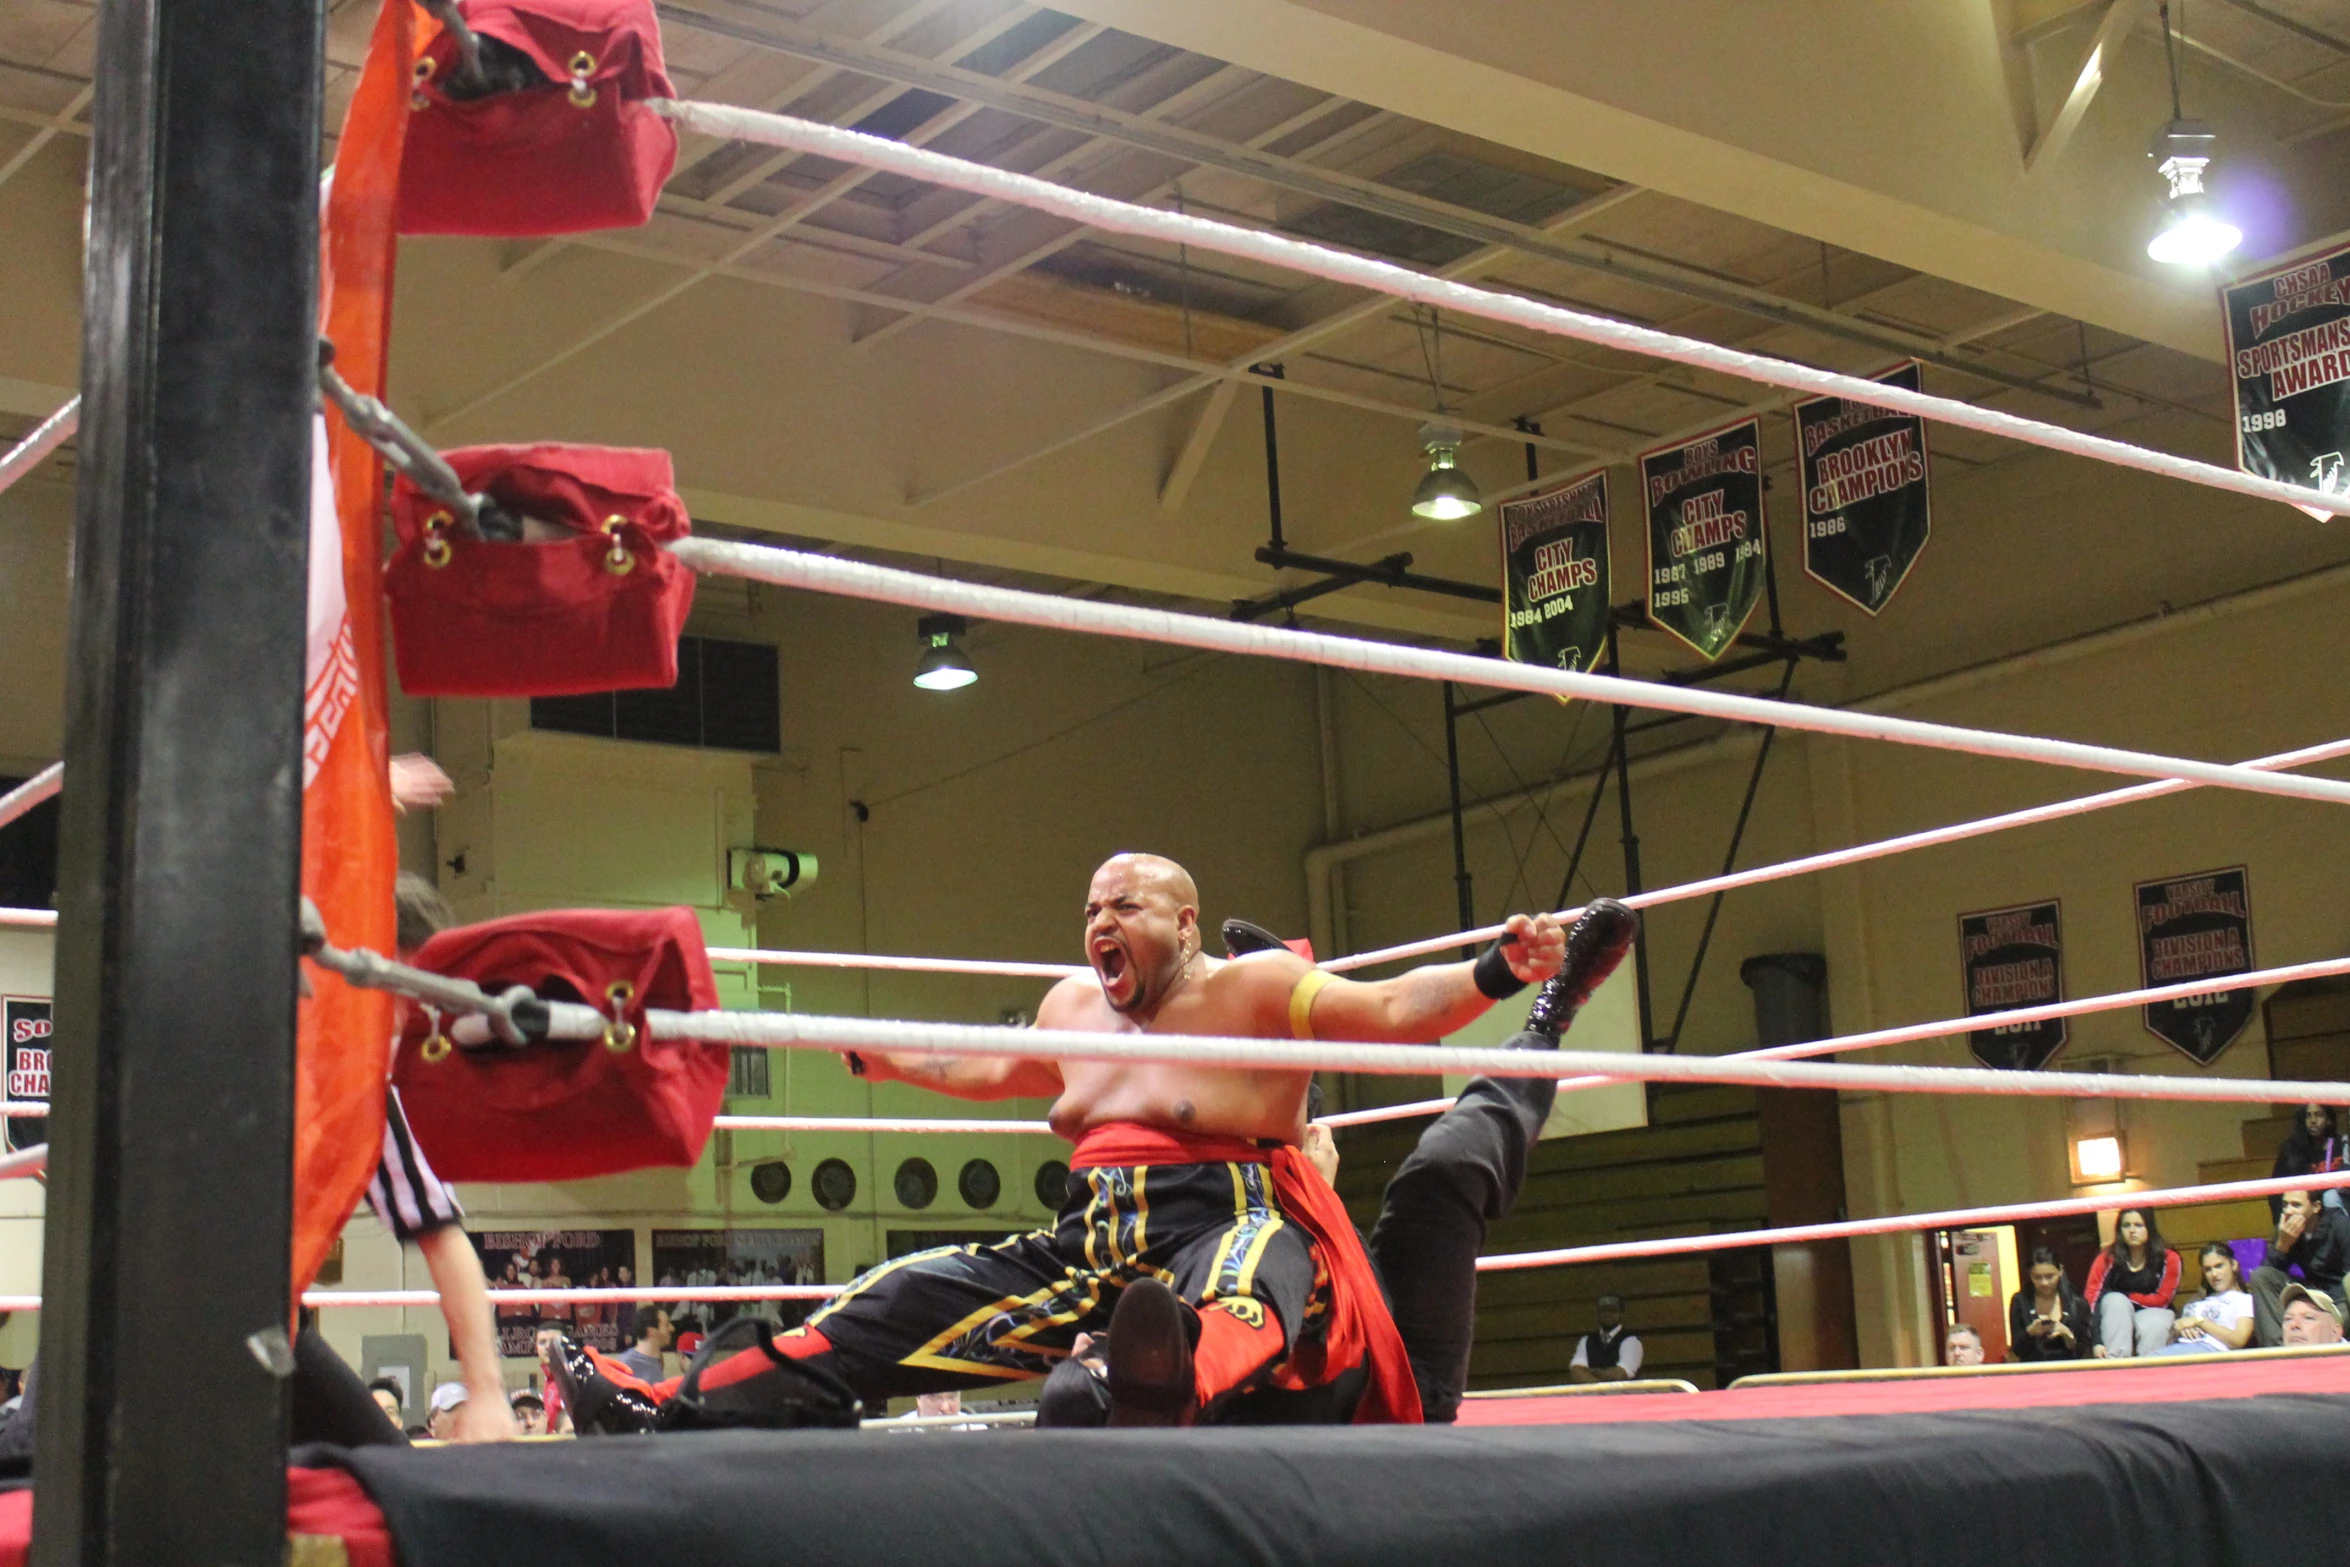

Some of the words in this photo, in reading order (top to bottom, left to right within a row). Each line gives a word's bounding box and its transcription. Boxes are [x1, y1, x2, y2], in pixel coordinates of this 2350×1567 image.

[2273, 262, 2331, 299] CHSAA
[2251, 276, 2350, 339] HOCKEY
[2271, 350, 2350, 402] AWARD
[2243, 408, 2287, 433] 1998
[1684, 439, 1719, 466] BOYS
[1816, 428, 1912, 486] BROOKLYN
[1650, 446, 1758, 507] BOWLING
[1810, 451, 1923, 514] CHAMPIONS
[1682, 489, 1724, 526] CITY
[1671, 511, 1747, 558] CHAMPS
[1810, 516, 1846, 538] 1986
[1535, 537, 1573, 573] CITY
[1528, 558, 1598, 603] CHAMPS
[1654, 588, 1689, 608] 1995
[1510, 608, 1543, 629] 1984
[1544, 595, 1573, 619] 2004
[2141, 891, 2245, 932] FOOTBALL
[1964, 923, 2058, 961] FOOTBALL
[2151, 930, 2225, 959] DIVISION
[2151, 947, 2245, 981] CHAMPIONS
[551, 1230, 600, 1249] FORD
